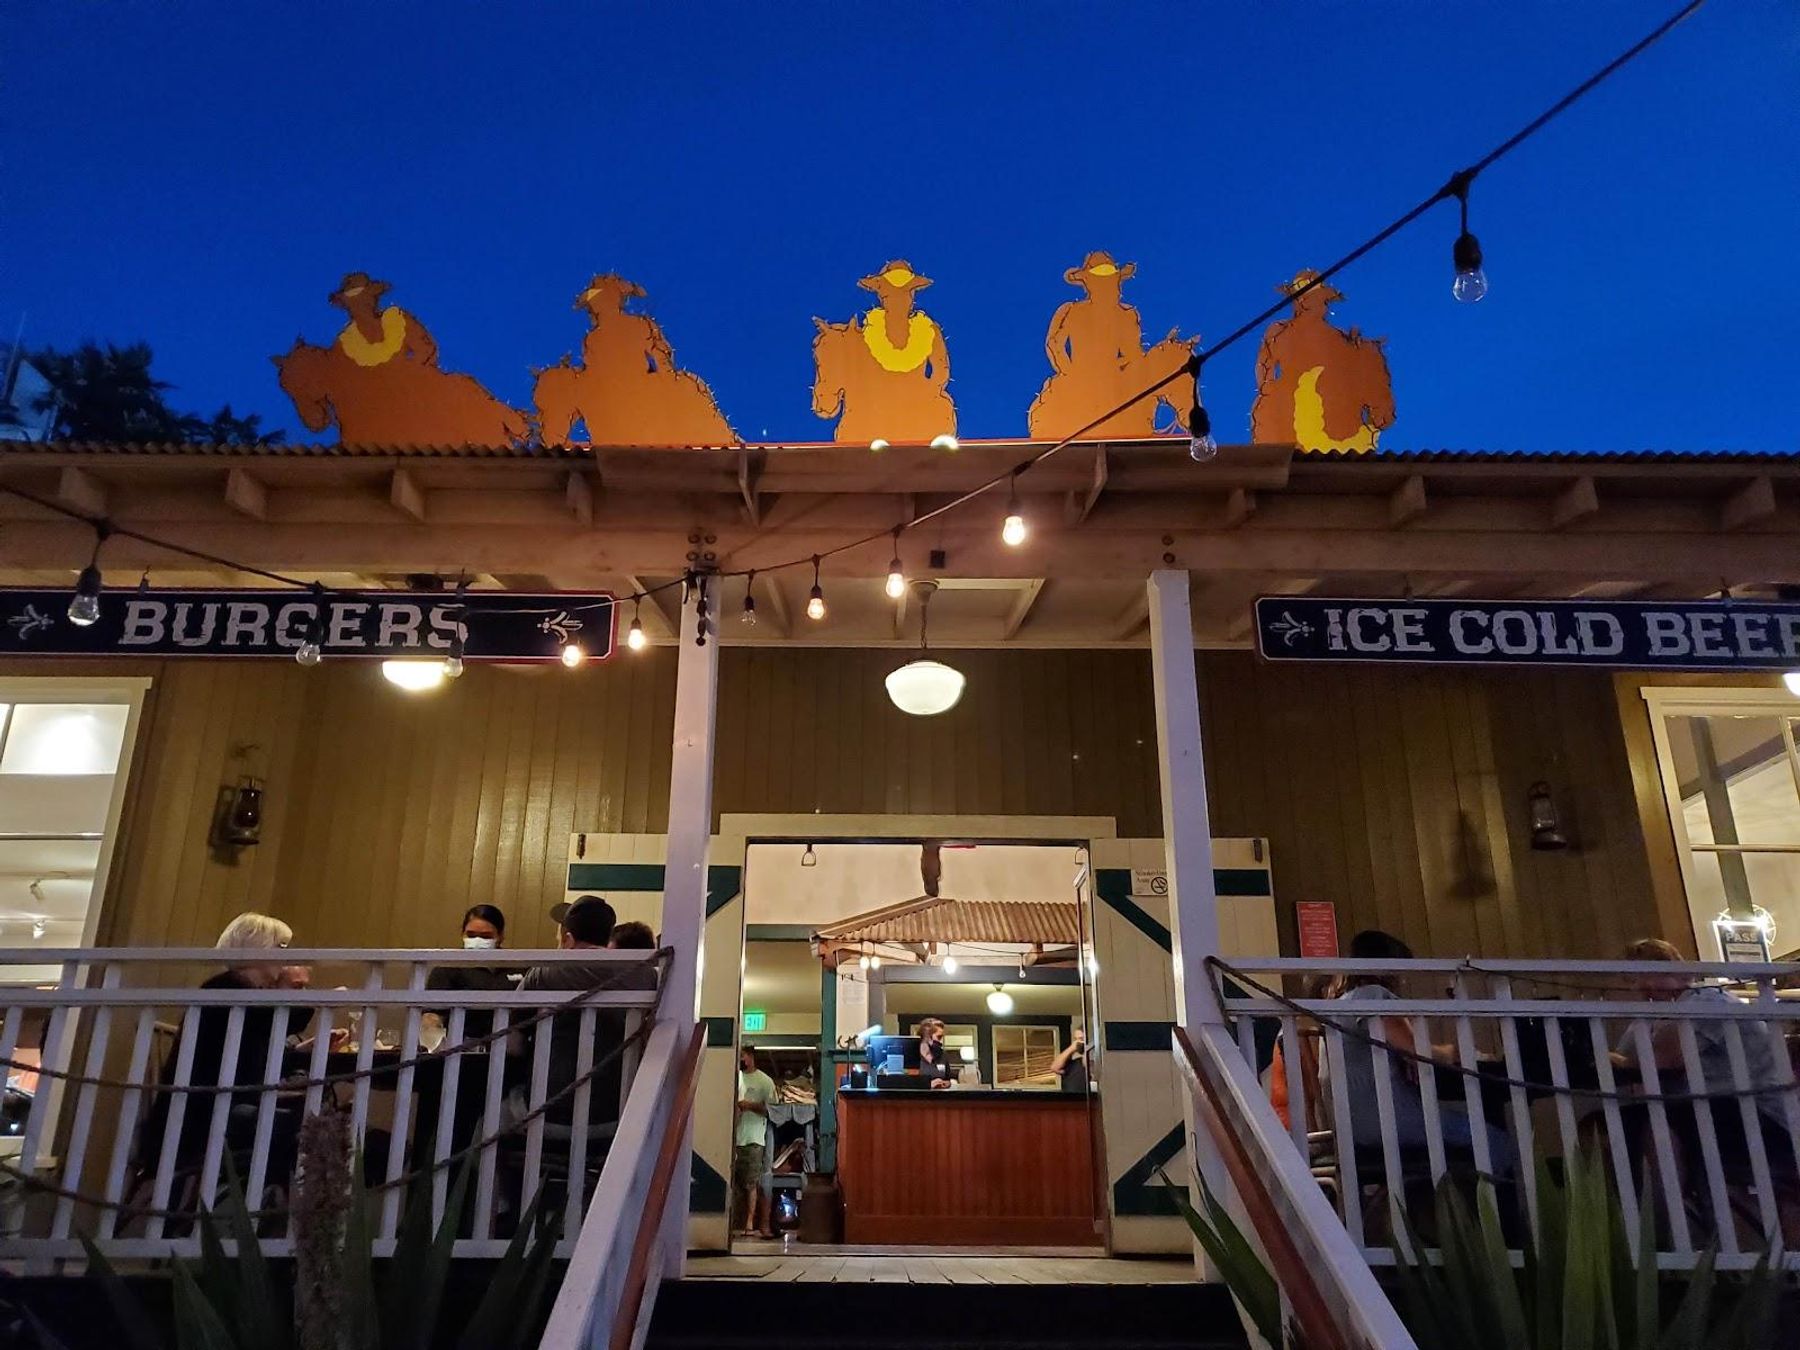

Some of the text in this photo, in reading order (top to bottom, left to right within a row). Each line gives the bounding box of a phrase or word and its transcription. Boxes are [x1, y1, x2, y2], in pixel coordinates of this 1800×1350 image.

[118, 601, 469, 648] BURGERS
[1323, 608, 1436, 652] ICE
[1449, 610, 1625, 656] COLD
[1726, 931, 1760, 943] PASS
